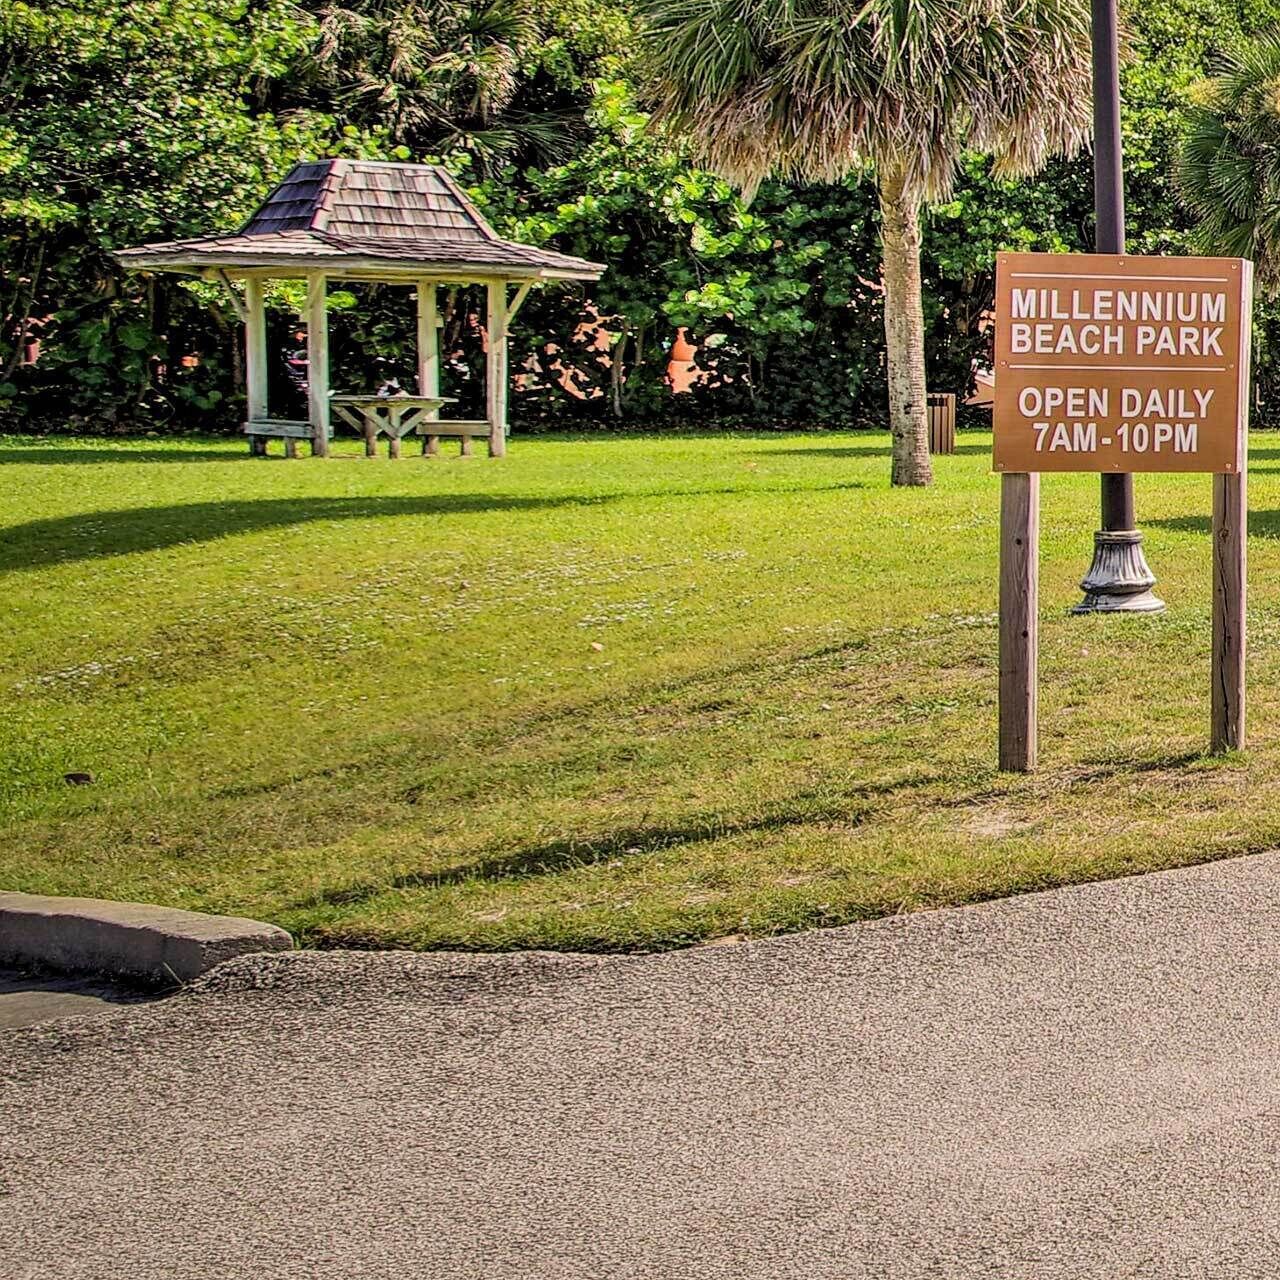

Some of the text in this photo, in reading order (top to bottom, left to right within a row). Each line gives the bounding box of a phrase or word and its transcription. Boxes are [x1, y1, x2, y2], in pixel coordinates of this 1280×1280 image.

[1011, 288, 1226, 322] MILLENNIUM
[1011, 324, 1224, 356] BEACH PARK
[1018, 387, 1215, 419] OPEN DAILY
